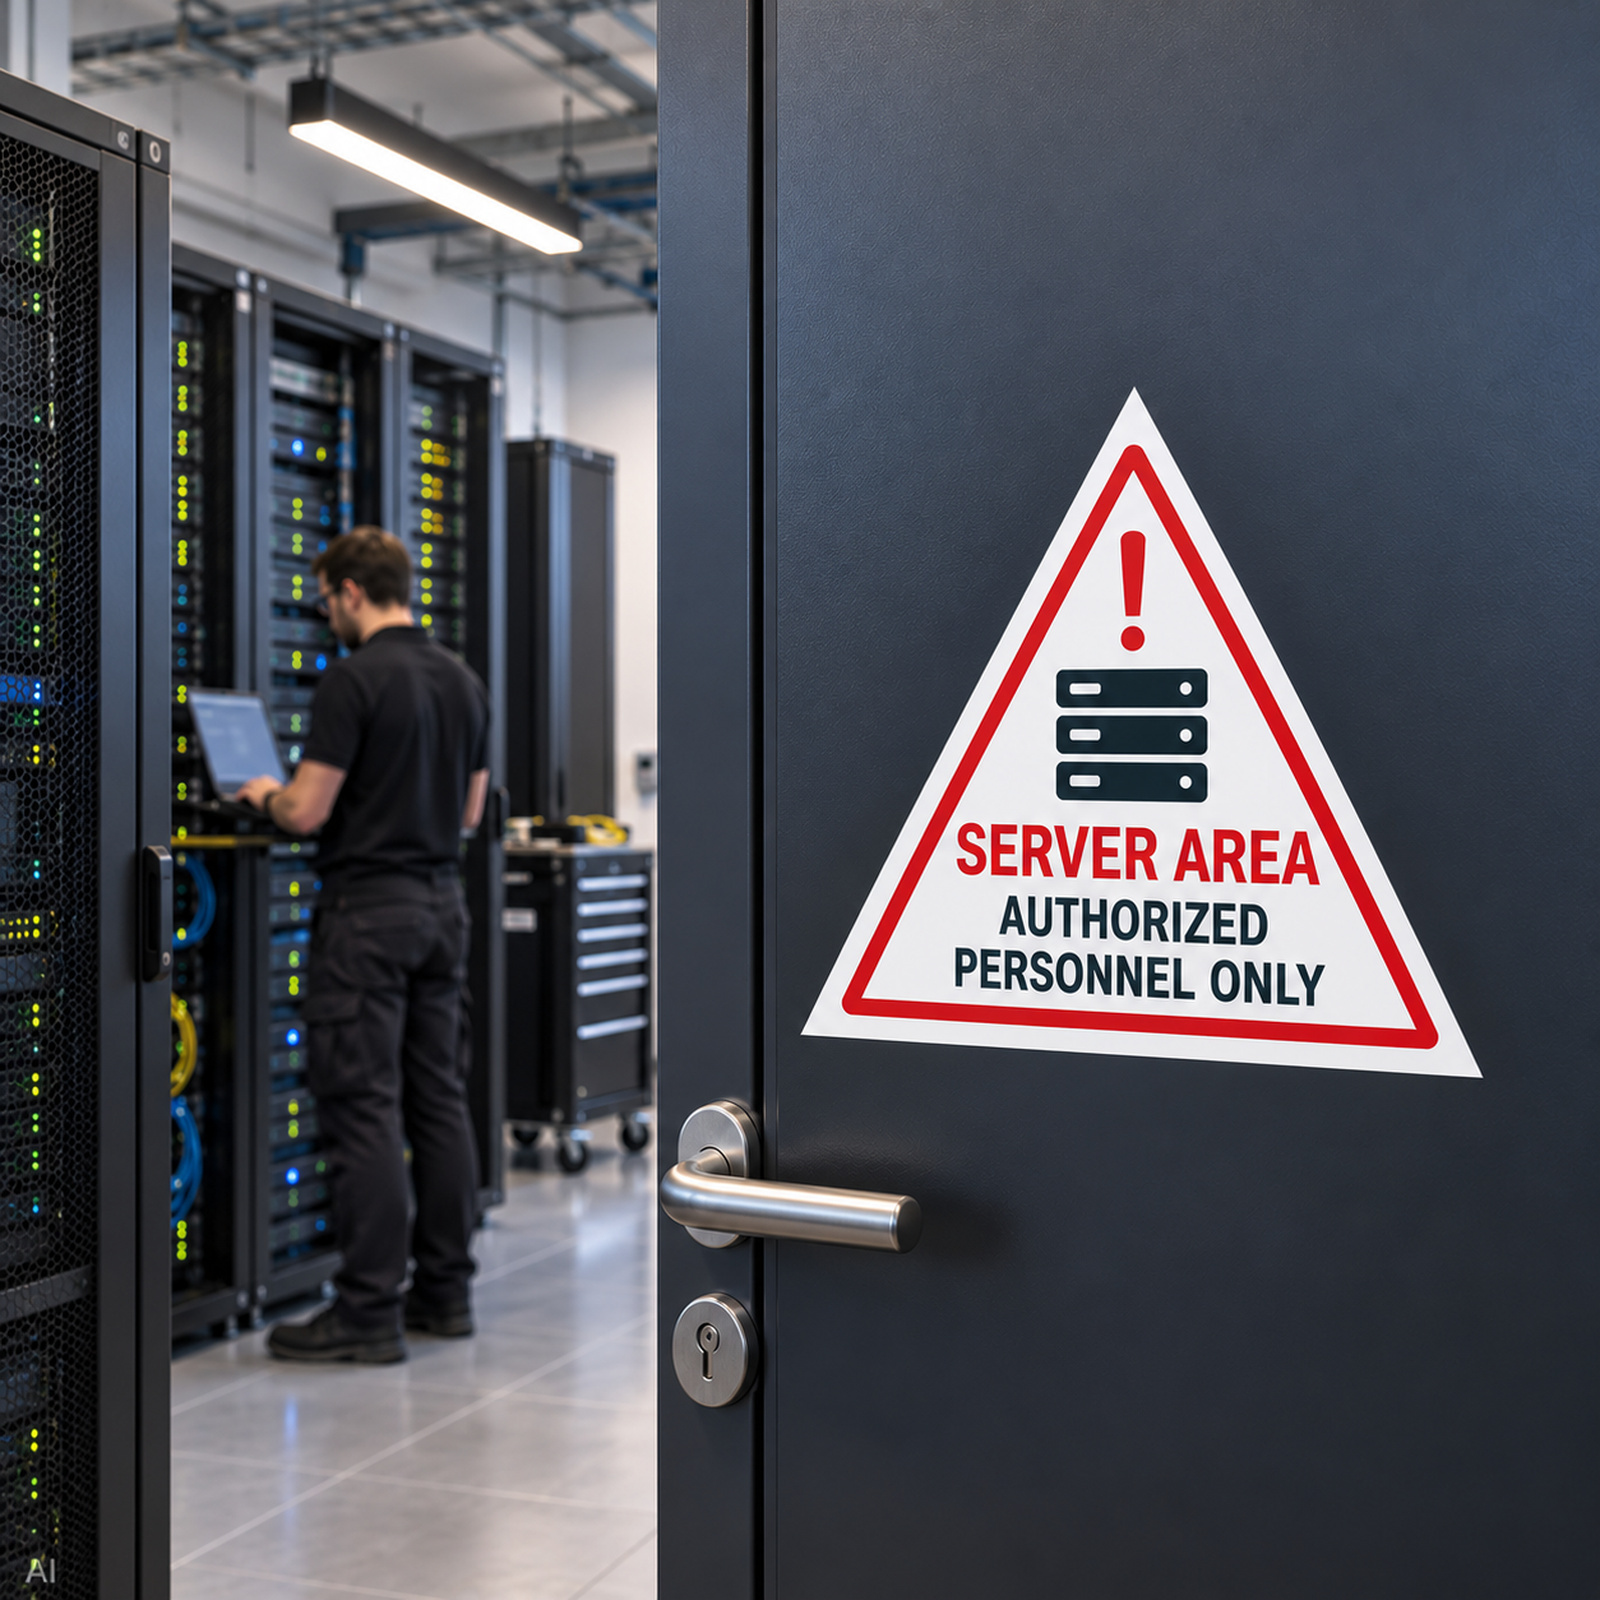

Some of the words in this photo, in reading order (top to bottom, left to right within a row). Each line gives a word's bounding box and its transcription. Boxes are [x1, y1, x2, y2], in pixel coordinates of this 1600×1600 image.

[956, 822, 1159, 881] SERVER
[1173, 828, 1321, 886] AREA
[999, 895, 1268, 946] AUTHORIZED
[955, 947, 1196, 1000] PERSONNEL
[1210, 959, 1326, 1007] ONLY
